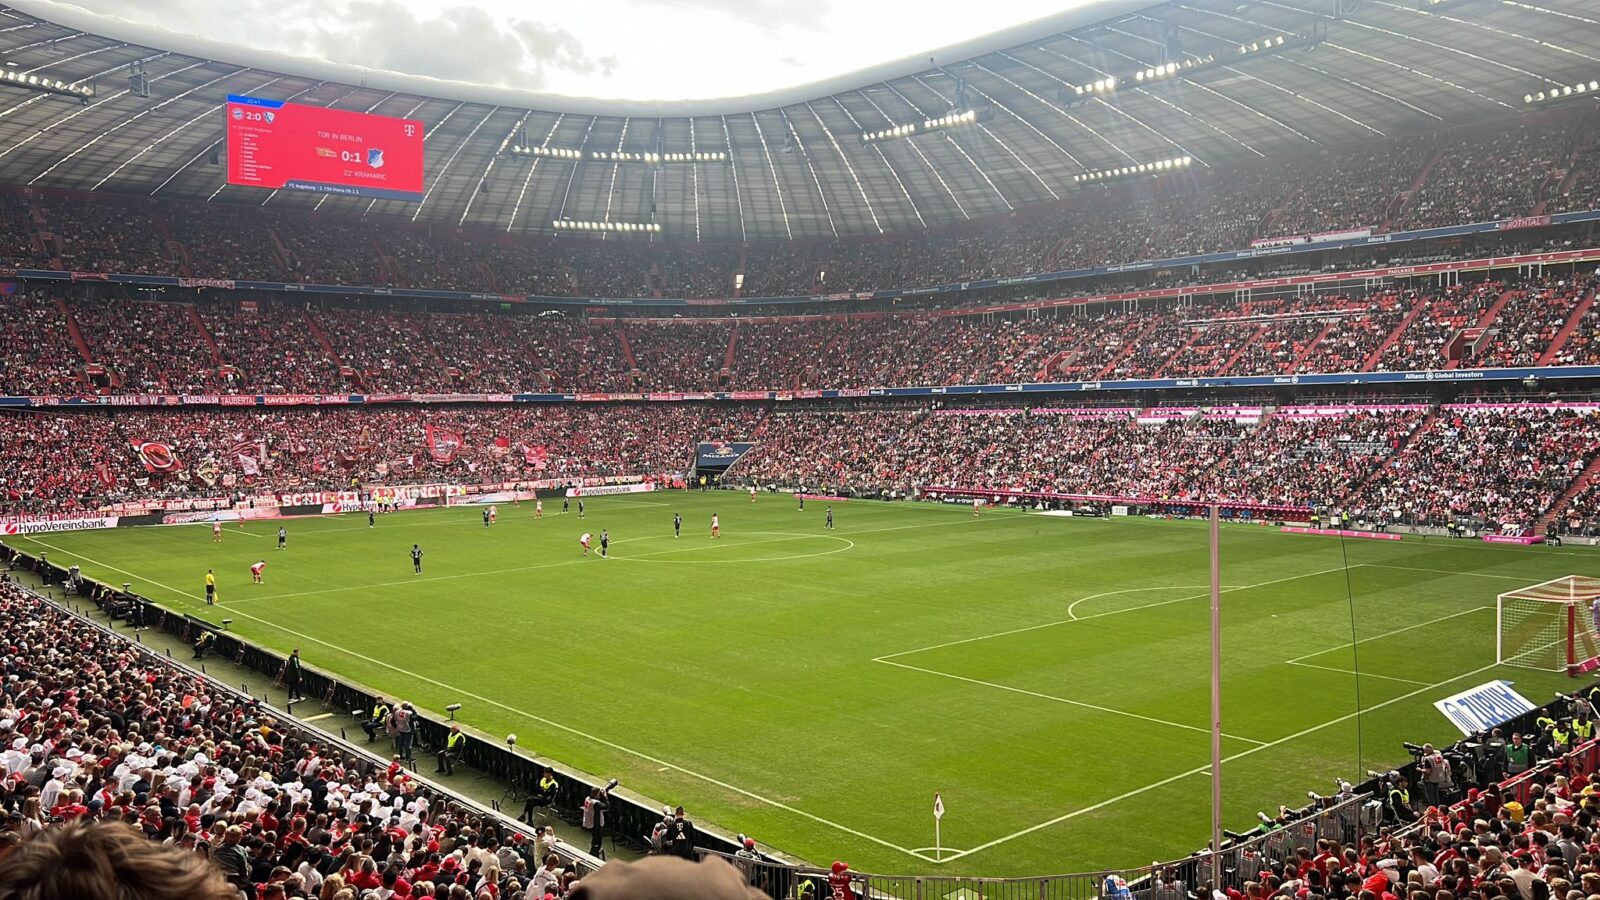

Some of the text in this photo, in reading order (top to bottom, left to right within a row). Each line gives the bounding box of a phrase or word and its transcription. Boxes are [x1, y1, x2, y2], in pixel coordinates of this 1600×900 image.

[246, 111, 262, 121] 2:0
[317, 130, 330, 139] TOR
[339, 134, 363, 143] BERLIN
[404, 124, 415, 137] T
[341, 150, 362, 163] 0:1
[1454, 370, 1484, 378] Investors
[842, 388, 869, 397] Zillertal
[581, 484, 632, 495] HypoVereinsbank
[19, 519, 107, 534] HypoVereinsbank
